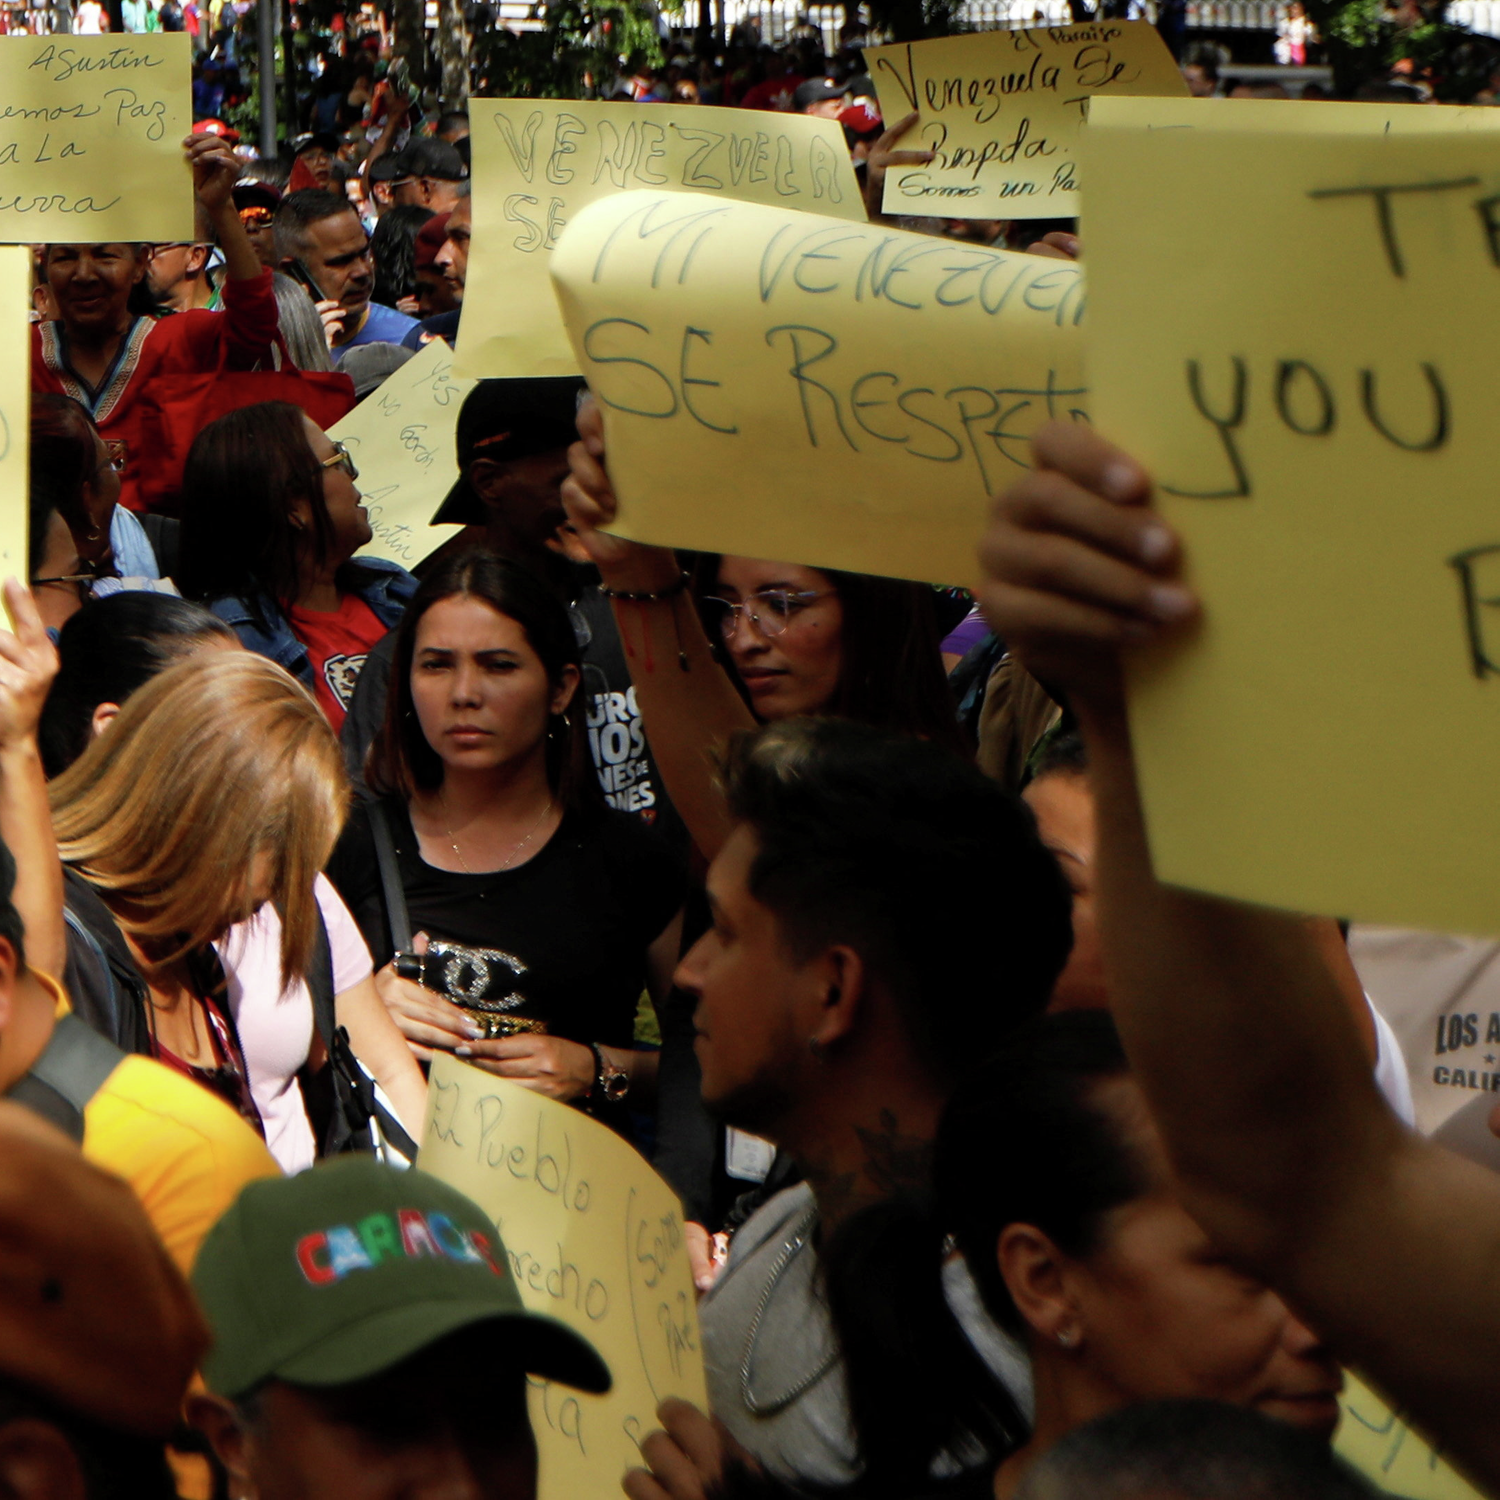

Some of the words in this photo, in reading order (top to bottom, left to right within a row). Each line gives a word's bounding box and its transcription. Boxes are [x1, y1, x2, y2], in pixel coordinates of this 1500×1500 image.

[876, 44, 1060, 124] Venezuela
[1049, 162, 1081, 198] Pa
[583, 317, 740, 434] SE
[765, 324, 1090, 497] RESPET
[1435, 1012, 1478, 1055] LOS
[1433, 1065, 1500, 1092] CALIF
[473, 1094, 592, 1211] Pueblo
[296, 1207, 504, 1285] CARACAS
[507, 1241, 610, 1321] recho
